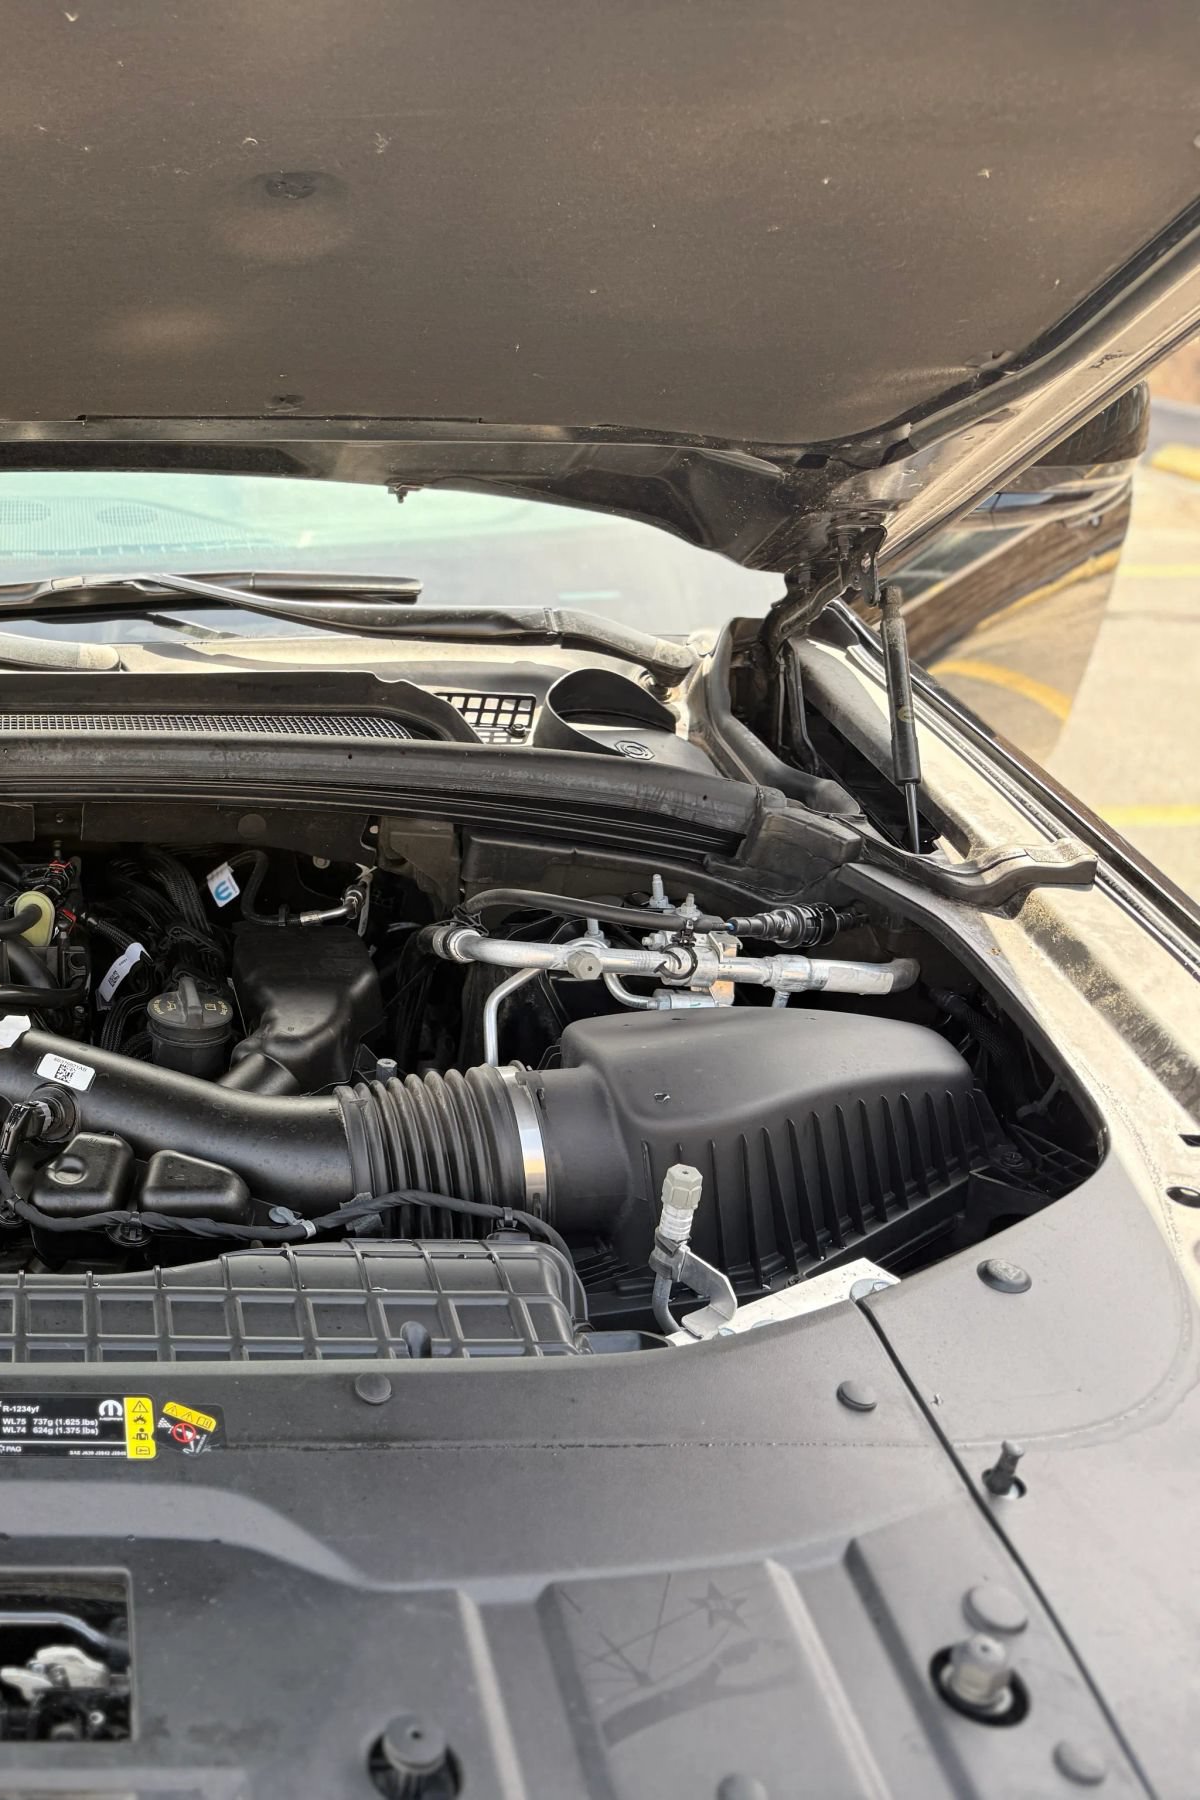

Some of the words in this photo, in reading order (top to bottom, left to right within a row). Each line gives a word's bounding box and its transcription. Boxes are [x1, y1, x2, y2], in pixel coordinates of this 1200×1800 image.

[2, 1405, 40, 1414] R-1234yf
[32, 1418, 54, 1427] 737g
[55, 1418, 80, 1426] (1.625
[81, 1418, 99, 1426] lbs)
[2, 1426, 27, 1434] WL74
[32, 1427, 54, 1435] 624g
[55, 1427, 81, 1435] (1.375
[81, 1427, 99, 1436] lbs)
[5, 1445, 22, 1453] PAG
